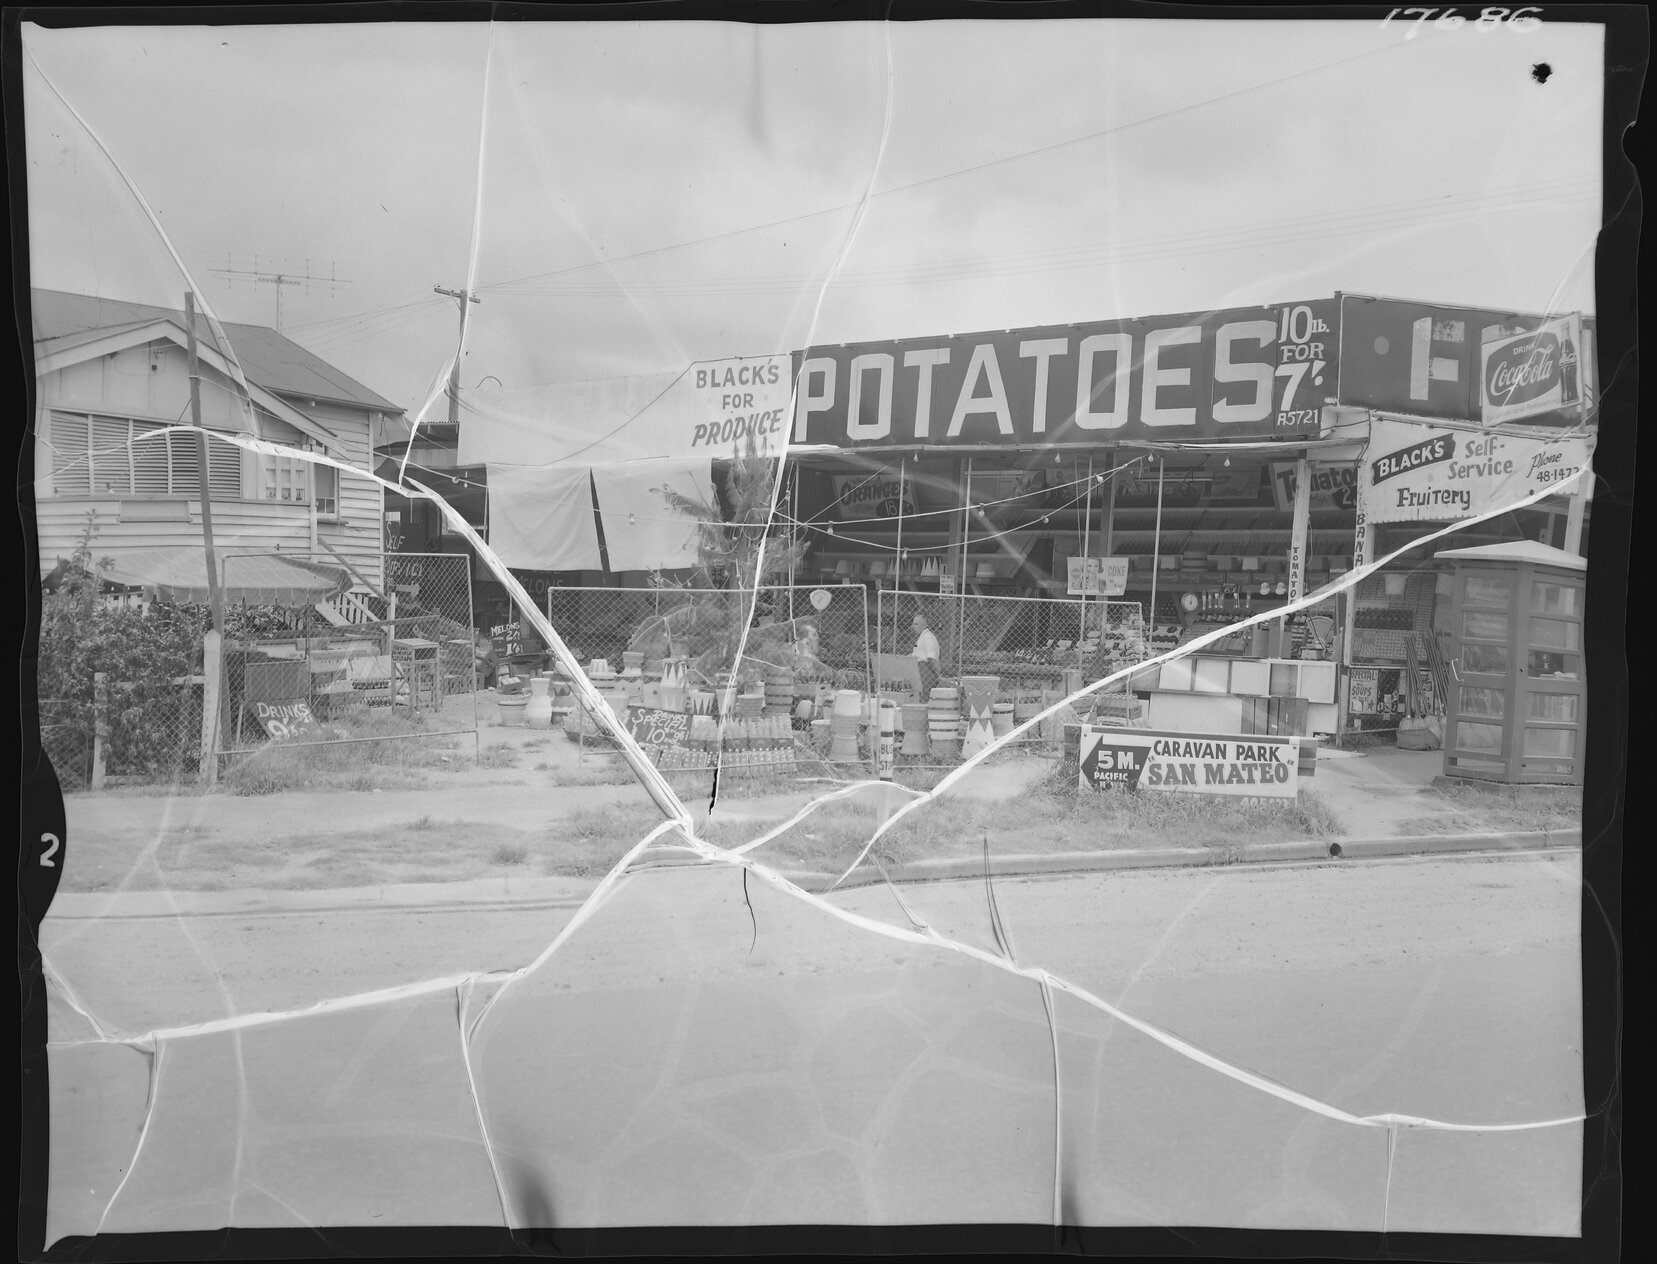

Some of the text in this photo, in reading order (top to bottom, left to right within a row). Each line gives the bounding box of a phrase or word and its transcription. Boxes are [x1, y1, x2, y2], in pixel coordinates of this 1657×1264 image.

[1280, 342, 1324, 363] FOR
[696, 358, 779, 389] BLACK'S
[795, 319, 1277, 443] POTATOES
[722, 392, 754, 411] FOR
[691, 407, 784, 448] PRODUCE
[1377, 439, 1446, 478] BLACK'S
[1448, 457, 1514, 481] Service
[1526, 451, 1563, 478] Phone
[1396, 486, 1472, 510] Fruitery
[1108, 565, 1126, 577] COKE
[490, 621, 521, 637] MELONS
[257, 702, 310, 718] DRINKS
[632, 708, 688, 731] SPECIAL
[652, 709, 689, 722] DRINKS
[1153, 740, 1281, 763] CARAVAN PARK
[1093, 771, 1129, 782] PACIFIC
[39, 832, 60, 868] 2
